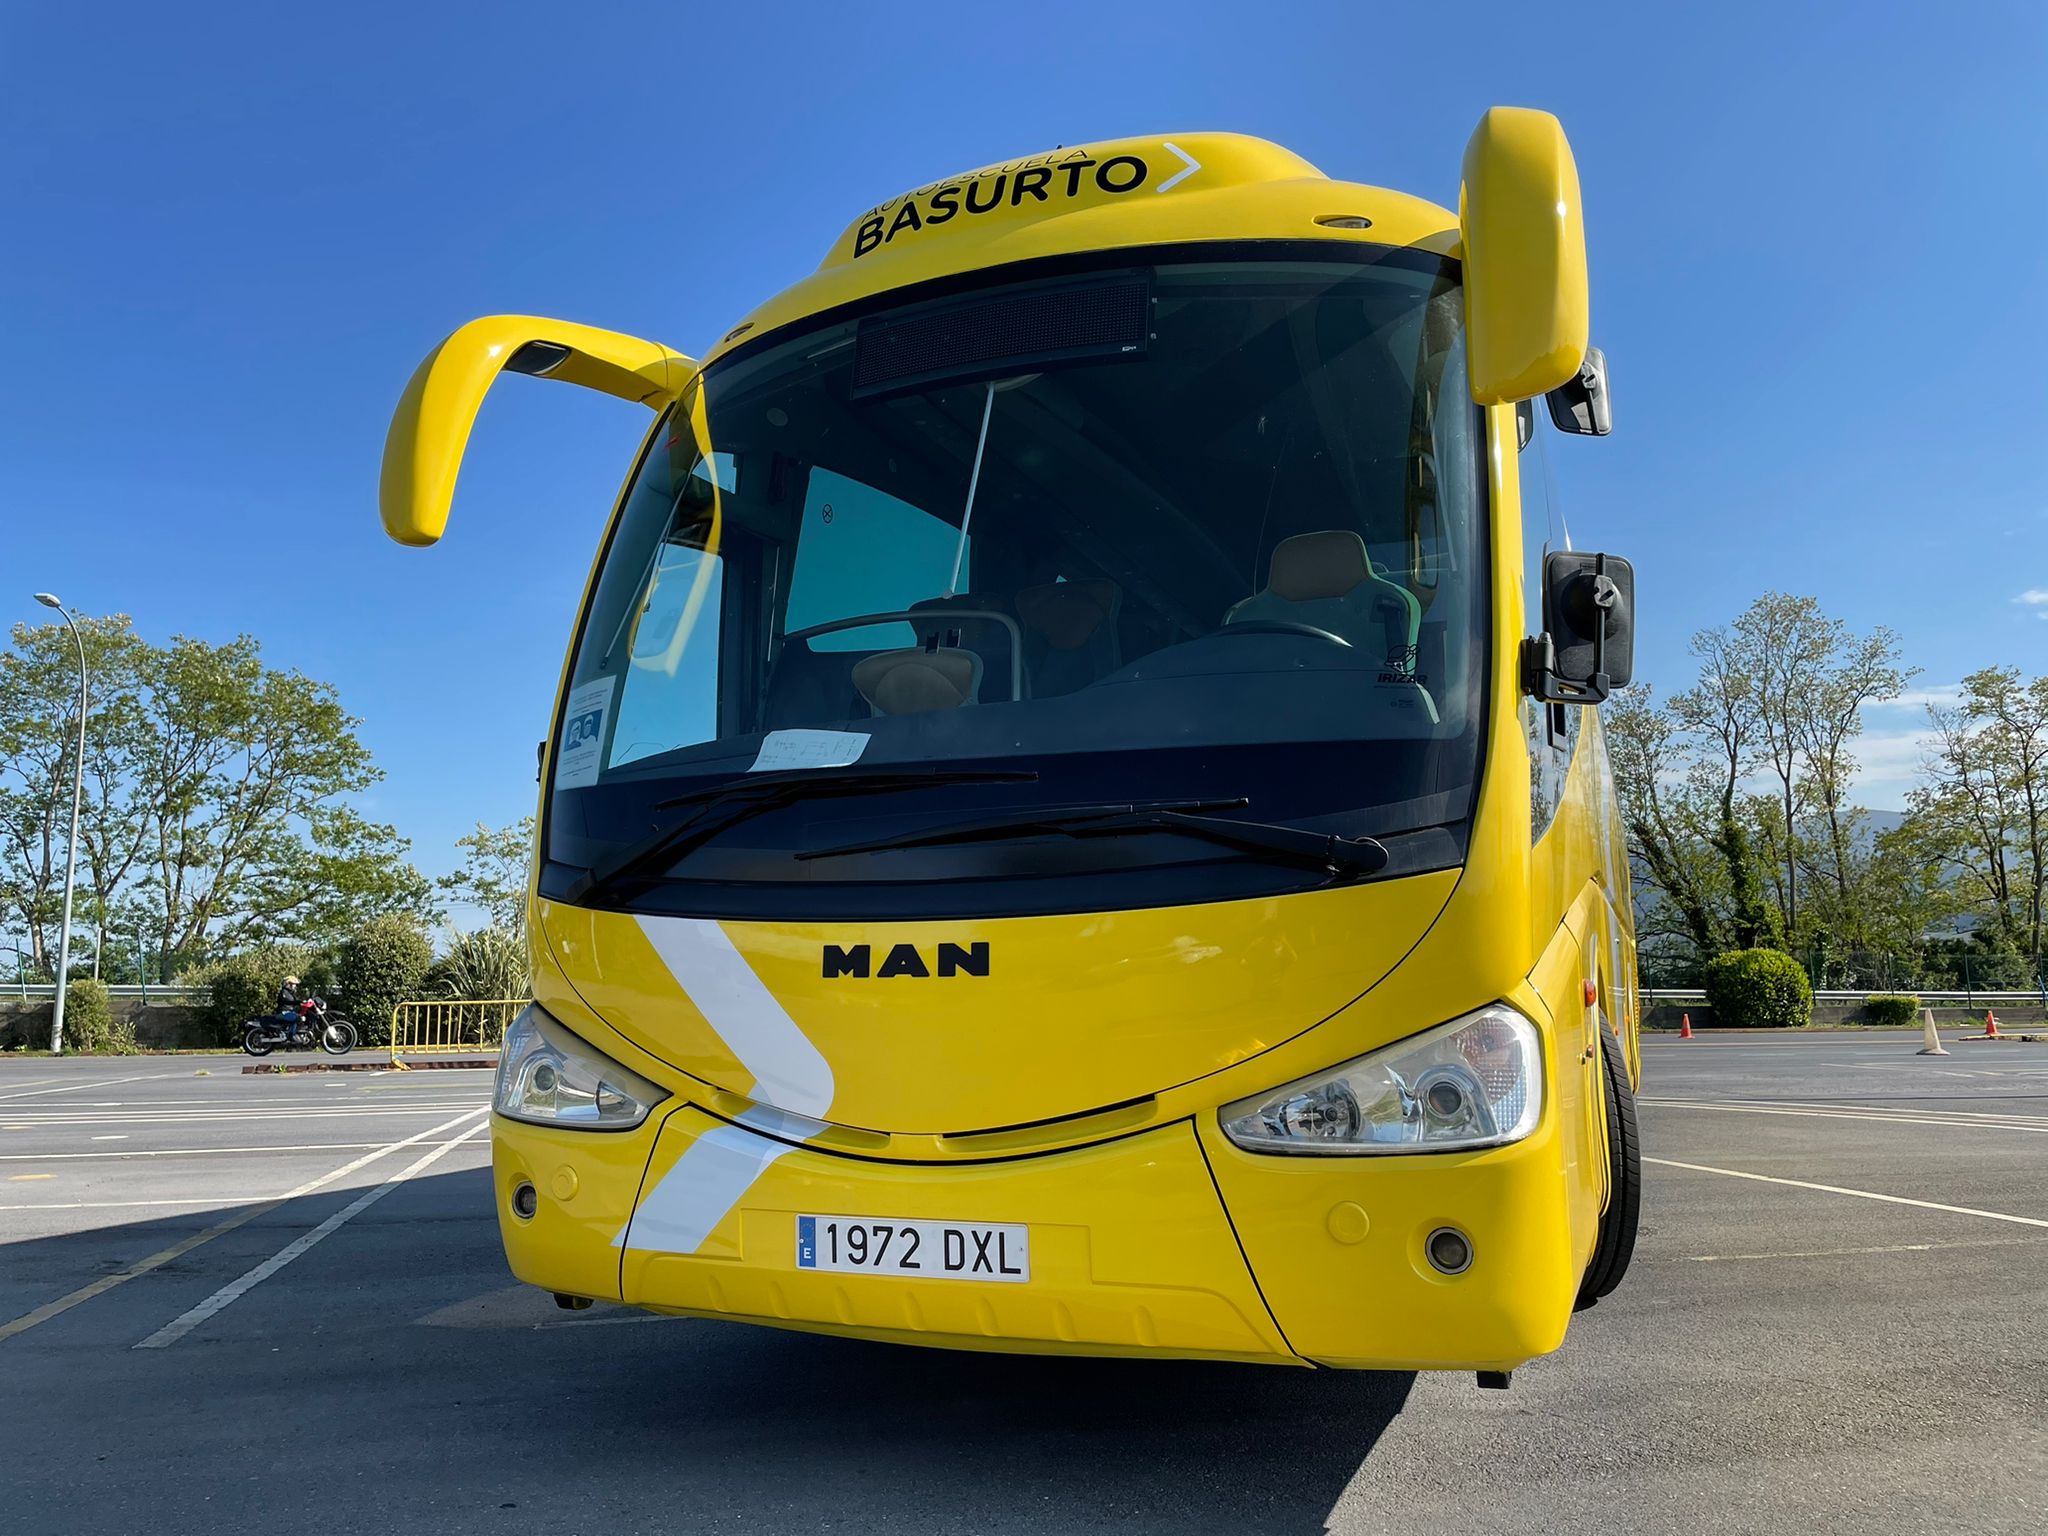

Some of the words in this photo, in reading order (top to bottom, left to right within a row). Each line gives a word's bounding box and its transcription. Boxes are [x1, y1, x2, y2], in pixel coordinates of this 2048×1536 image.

[854, 156, 1148, 259] BASURTO
[861, 149, 1088, 223] AUTOESCUELA
[823, 942, 989, 978] MAN
[803, 1247, 812, 1259] E
[827, 1223, 921, 1268] 1972
[943, 1229, 1021, 1274] DXL
